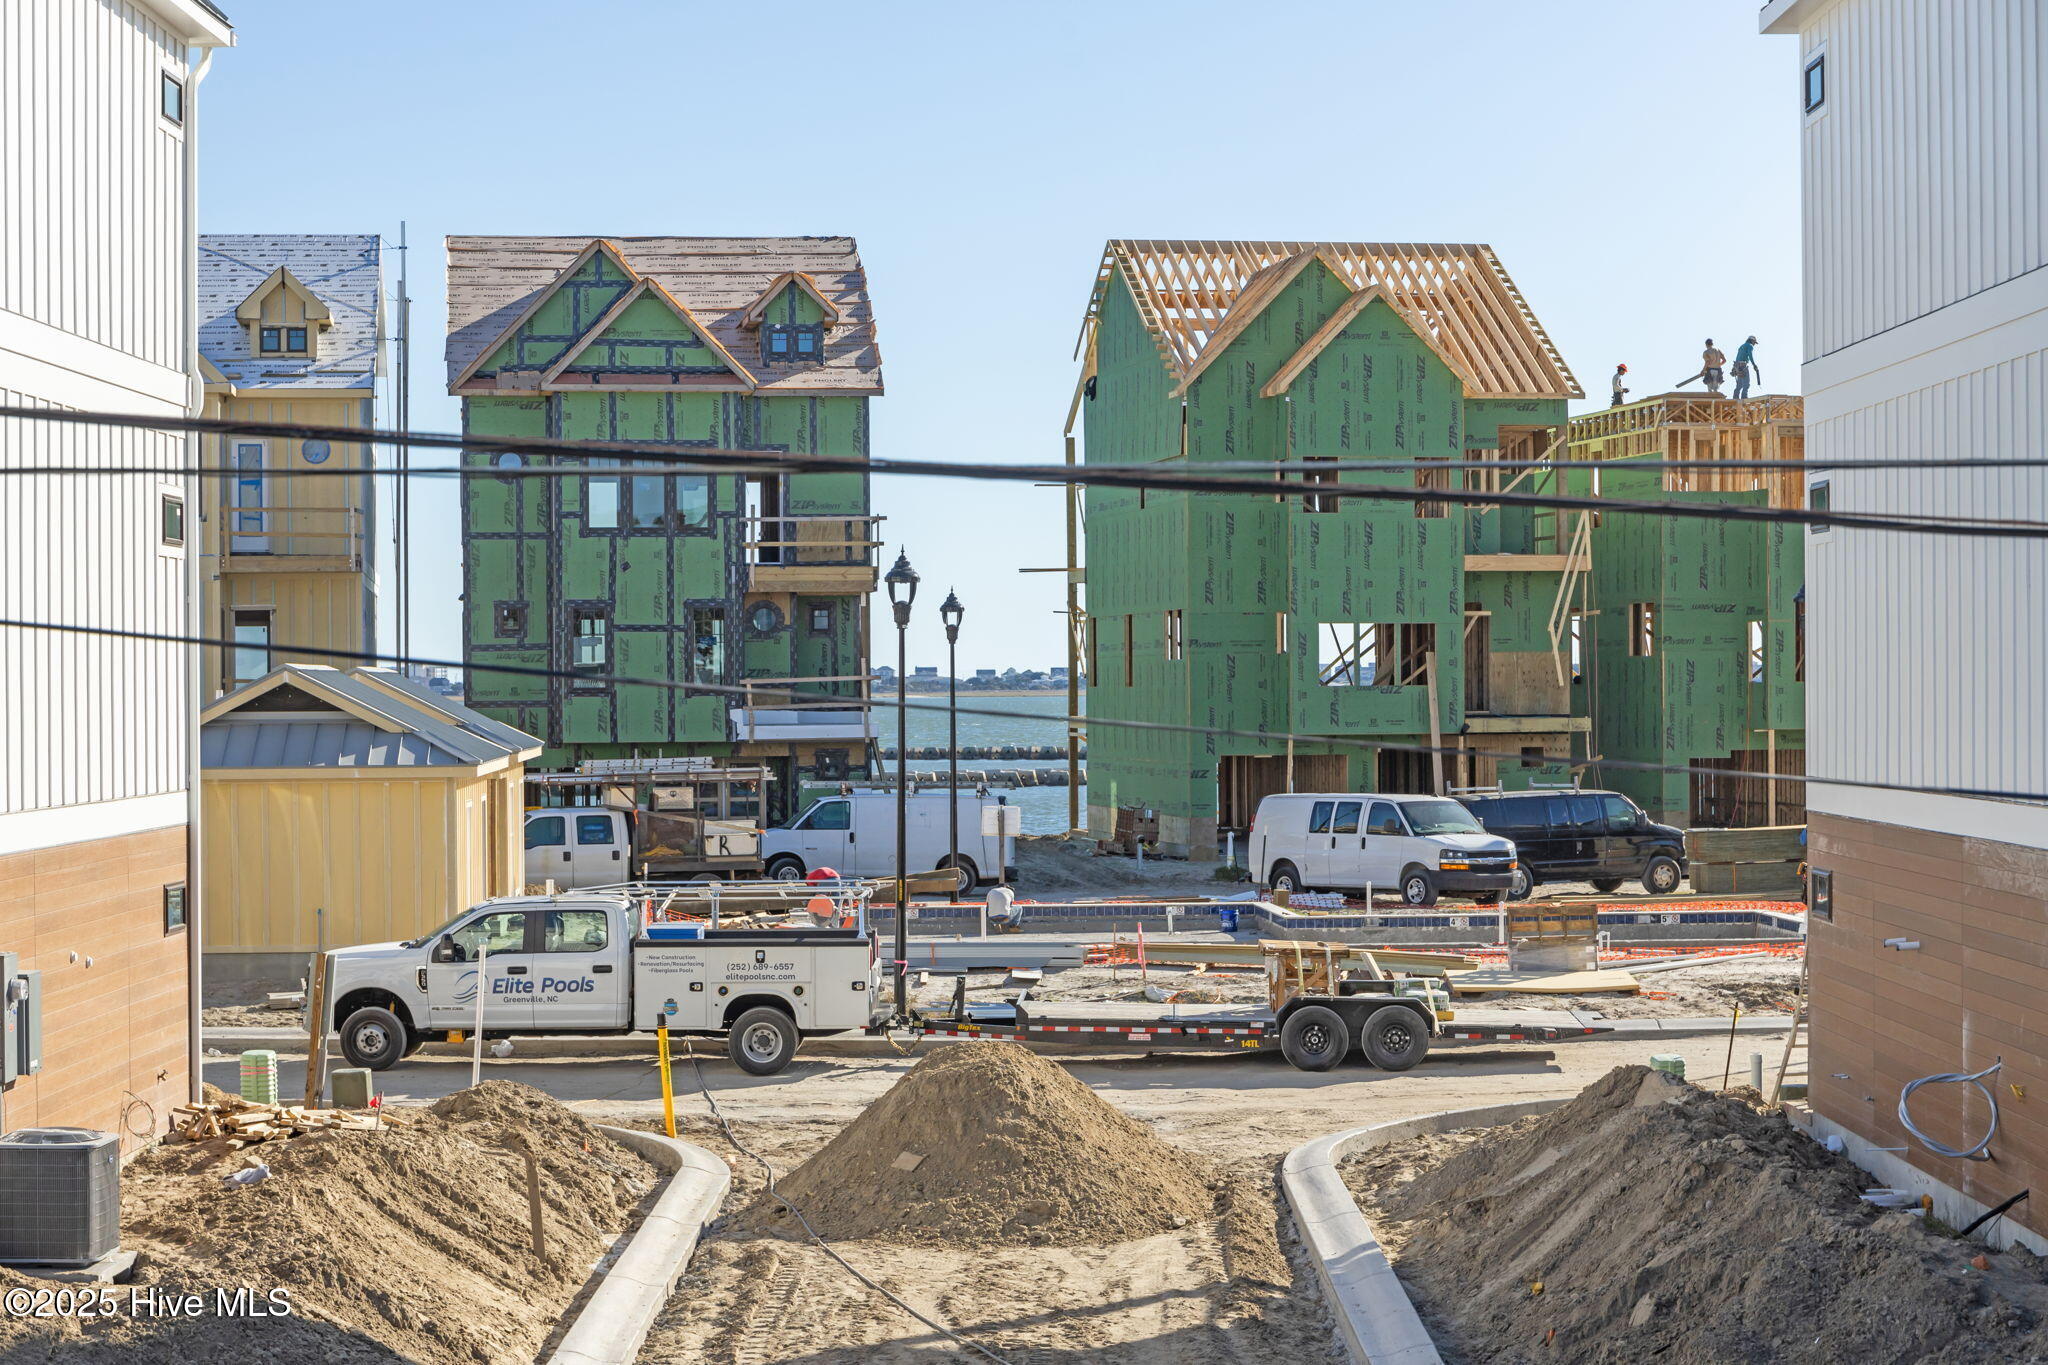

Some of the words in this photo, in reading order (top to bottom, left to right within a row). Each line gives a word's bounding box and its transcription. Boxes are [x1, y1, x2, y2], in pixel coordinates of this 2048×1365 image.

[726, 963, 751, 971] (252)
[753, 963, 795, 971] 689-6557
[725, 973, 796, 982] elitepoolsnc.com
[492, 978, 535, 994] Elite
[541, 976, 595, 993] Pools
[503, 996, 546, 1004] Greenville,
[547, 995, 559, 1003] NC
[1241, 1039, 1260, 1048] 14TL
